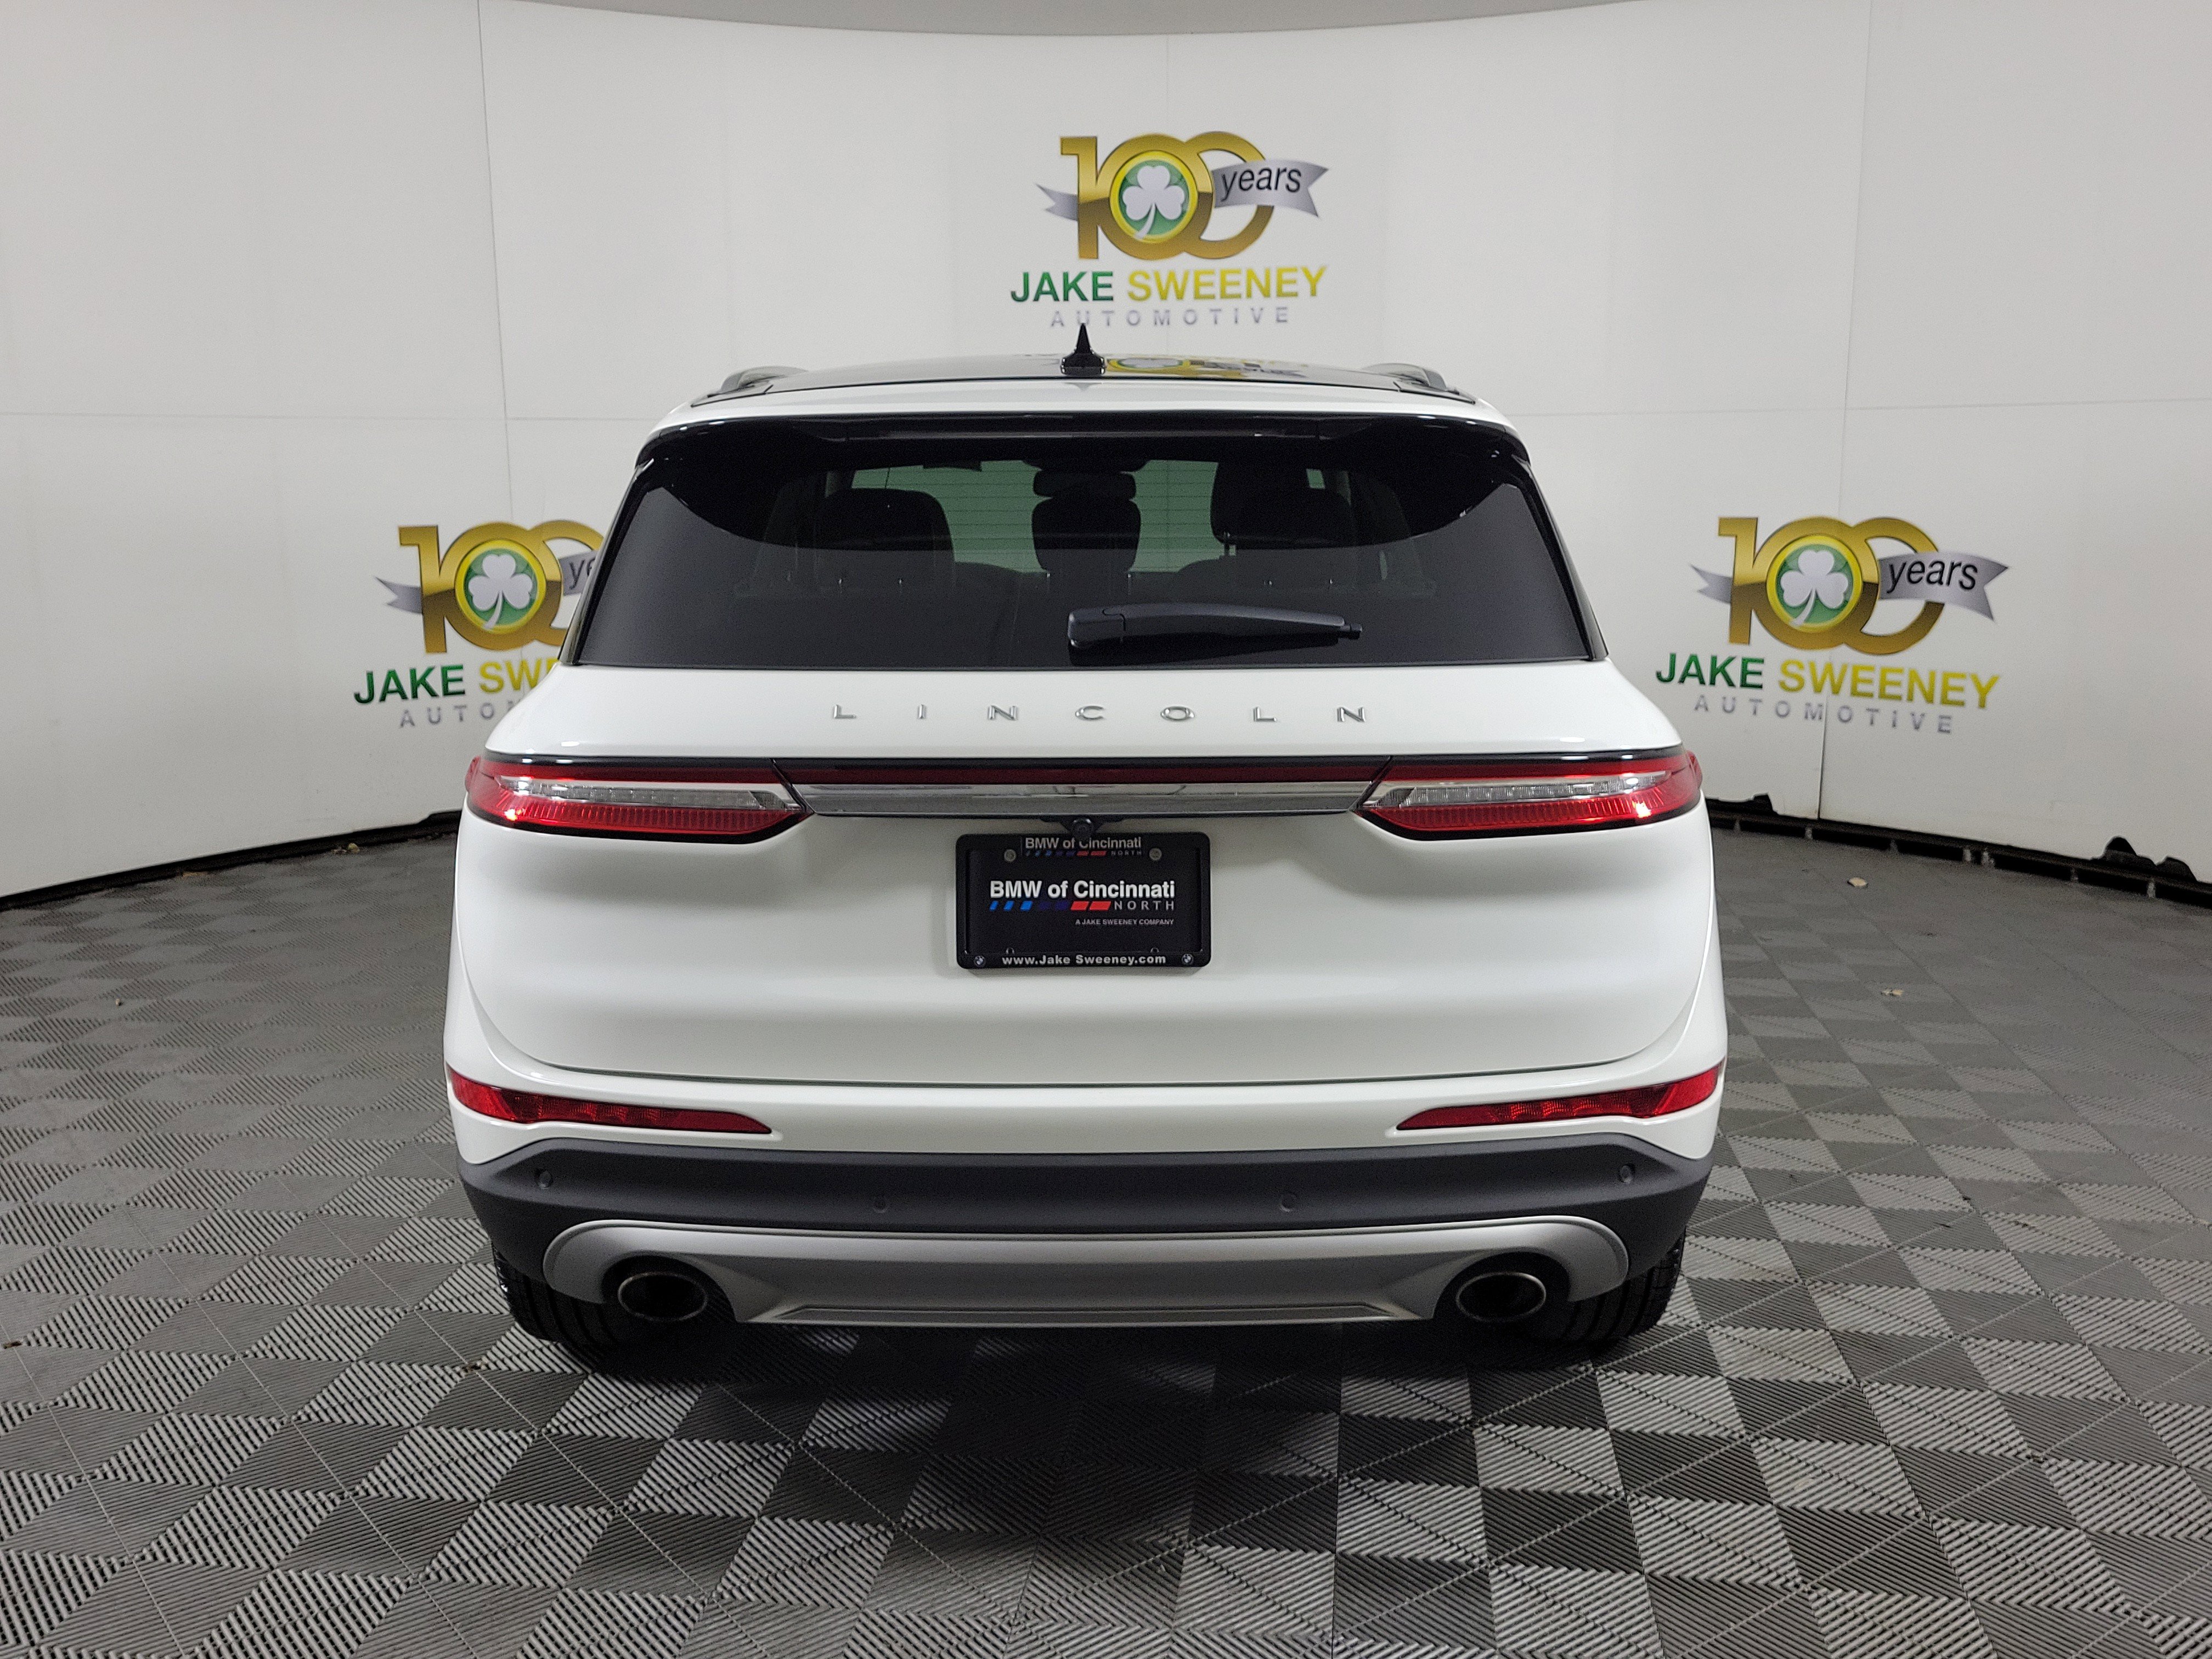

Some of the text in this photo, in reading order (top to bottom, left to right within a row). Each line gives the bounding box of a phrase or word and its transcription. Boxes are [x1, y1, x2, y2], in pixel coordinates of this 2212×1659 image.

[1060, 131, 1274, 261] 100
[1220, 166, 1302, 202] years
[1011, 266, 1327, 302] JAKE SWEENEY
[1050, 306, 1289, 328] AUTOMOTIVE
[1718, 516, 1944, 656] 100
[1887, 559, 1978, 594] years
[353, 664, 465, 704] JAKE
[1656, 652, 2001, 709] JAKE SWEENEY
[833, 703, 1367, 723] LINCOLN
[1694, 694, 1953, 734] AUTOMOTIVE
[1025, 837, 1059, 849] BMW
[1063, 837, 1075, 849] of
[990, 880, 1175, 898] BMW of Cincinnati
[1114, 900, 1175, 911] NORTH
[1002, 954, 1166, 966] www.Jake Sweeney.com
